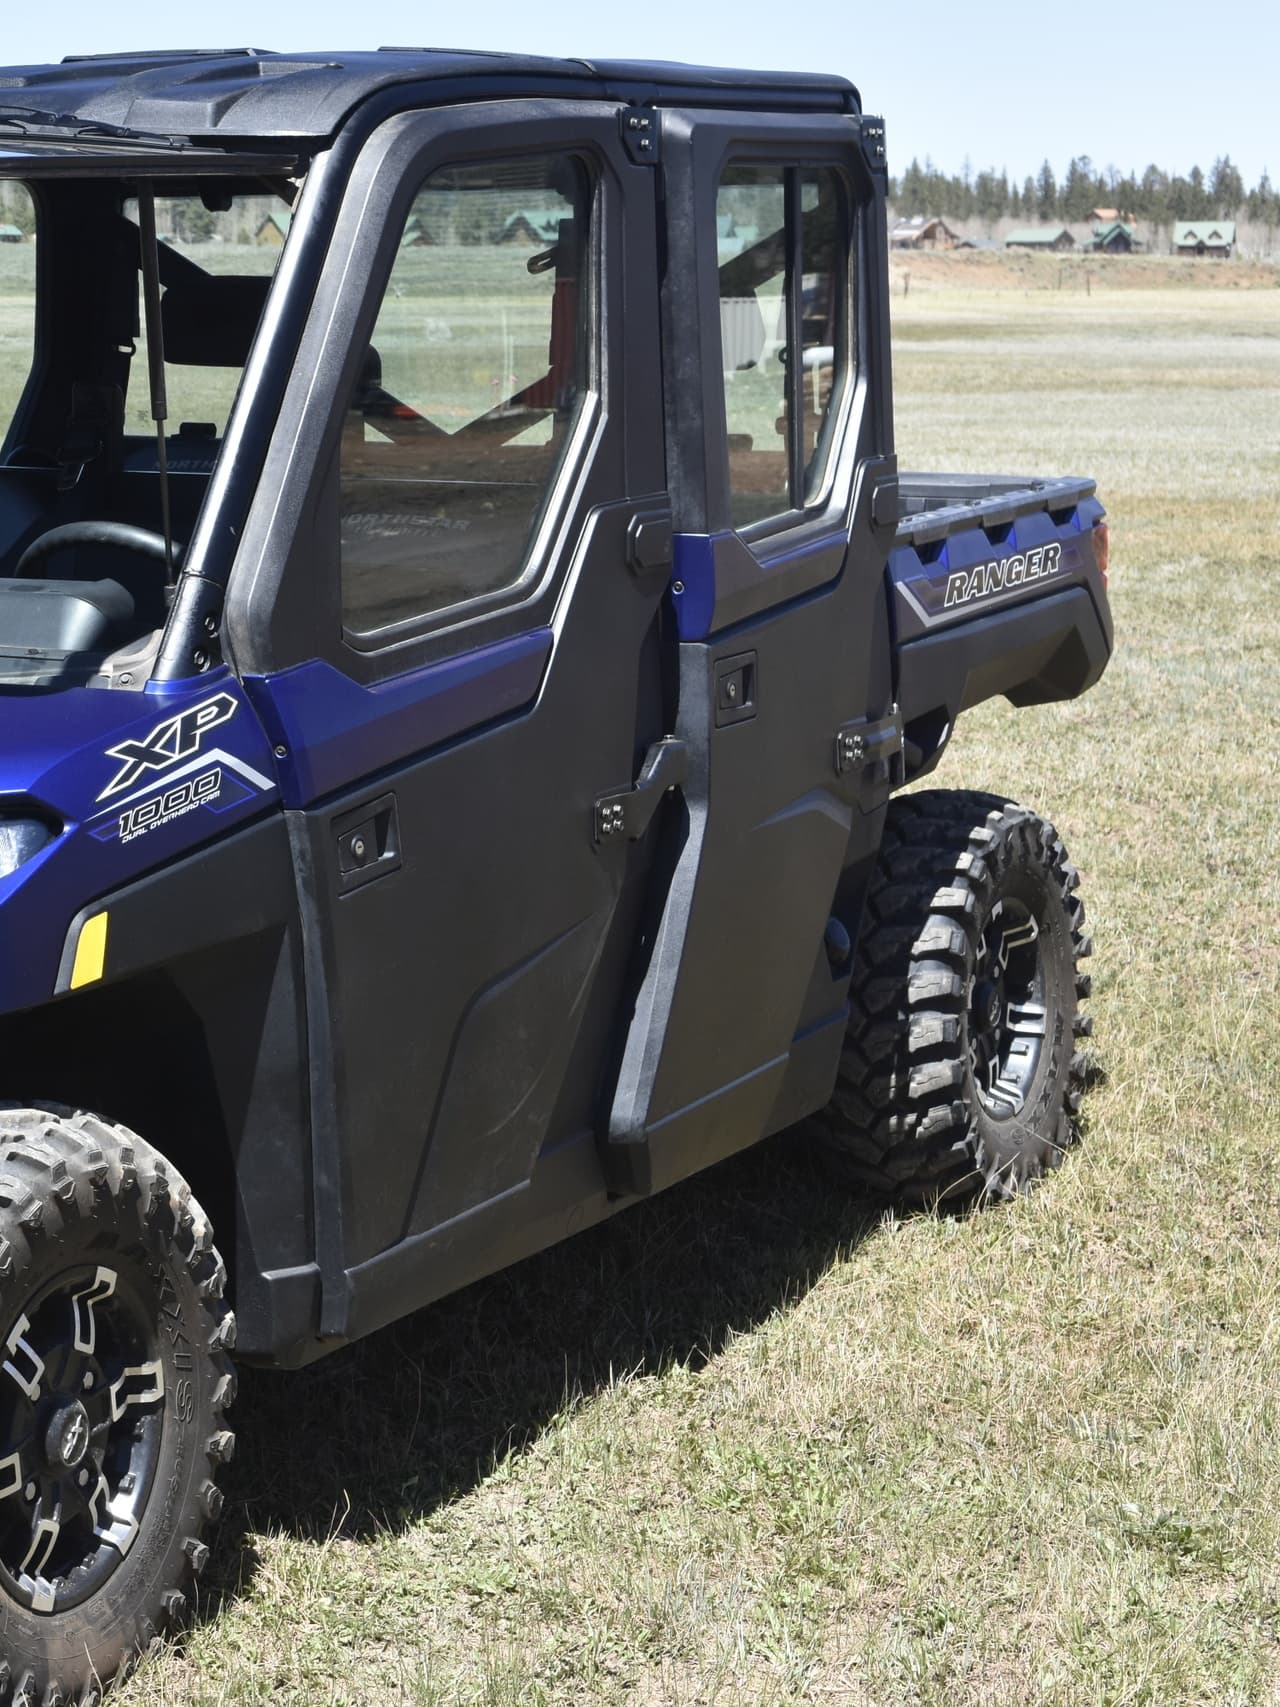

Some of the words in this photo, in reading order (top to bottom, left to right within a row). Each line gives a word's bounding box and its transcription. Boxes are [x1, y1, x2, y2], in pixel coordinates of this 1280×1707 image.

[943, 542, 1062, 608] RANGER
[96, 691, 239, 802] XP
[118, 767, 222, 838] 1000
[121, 827, 149, 844] DUAL
[149, 800, 200, 830] OVERHEAD
[200, 790, 221, 805] CAM
